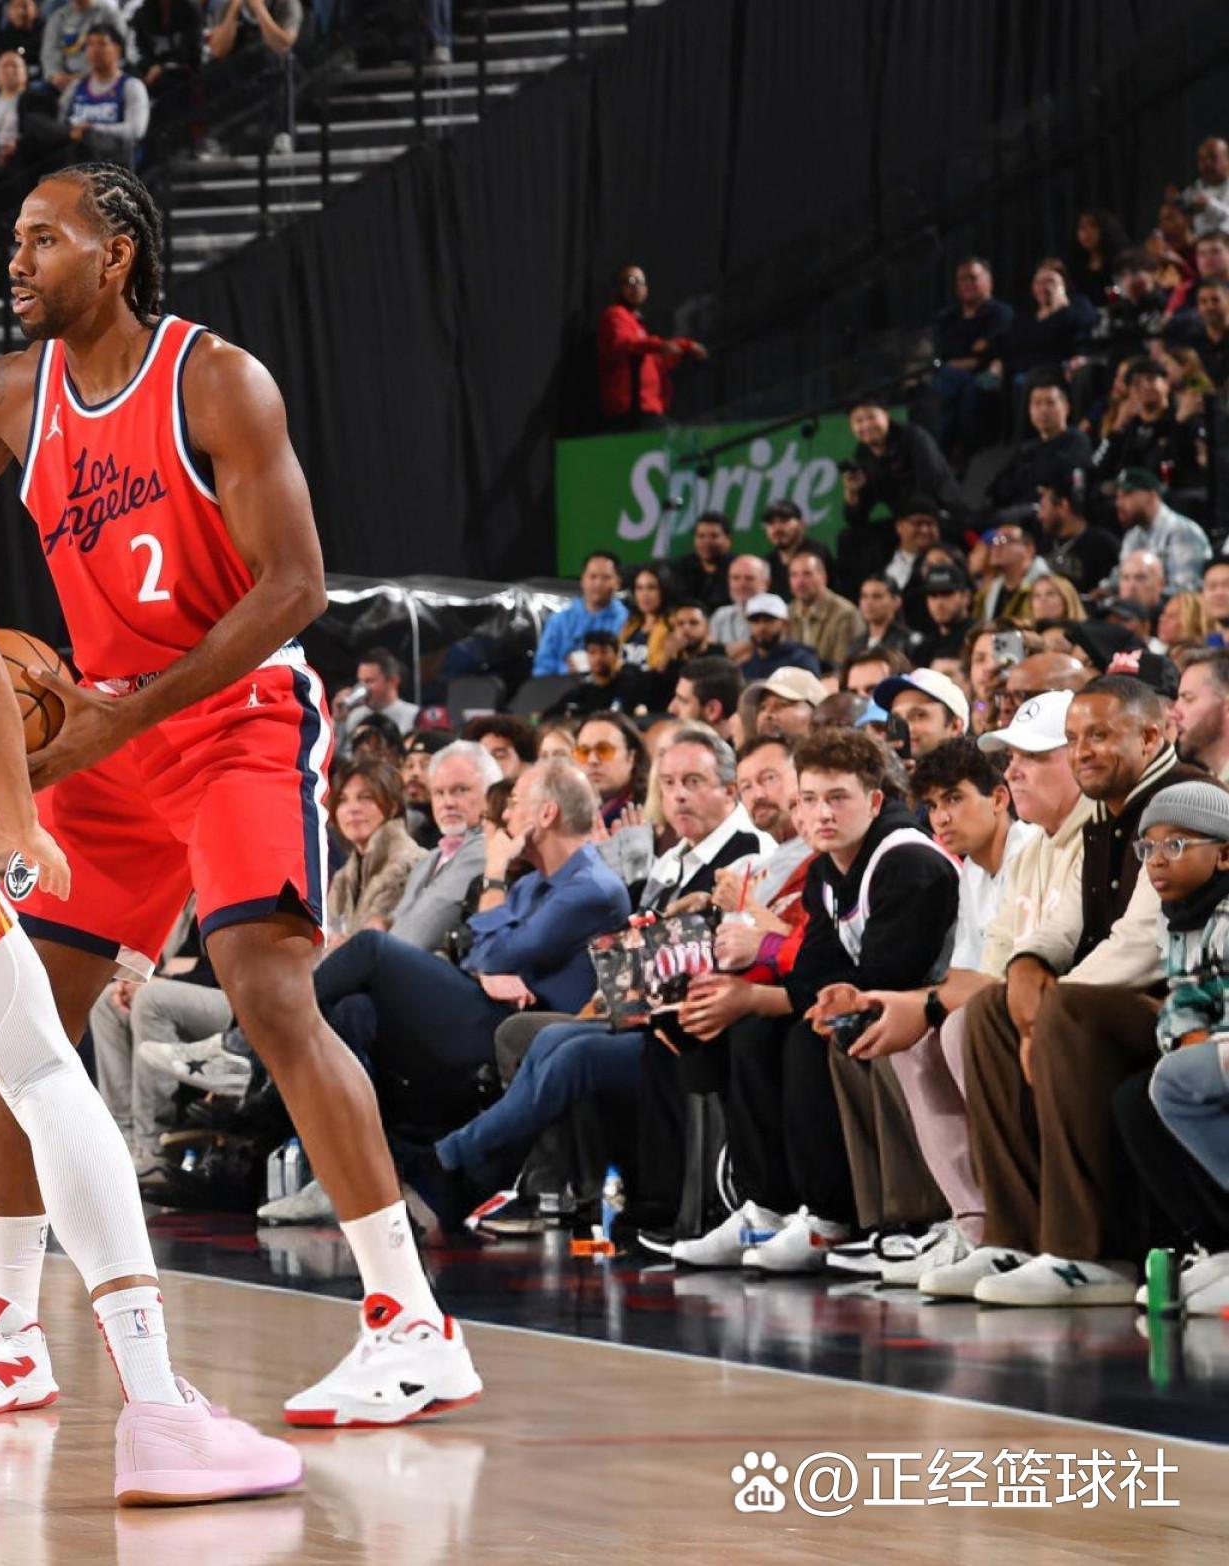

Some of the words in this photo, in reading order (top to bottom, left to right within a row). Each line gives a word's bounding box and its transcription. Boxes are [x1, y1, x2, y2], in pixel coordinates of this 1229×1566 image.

[67, 447, 120, 501] Los
[616, 436, 839, 559] Sprite
[130, 533, 171, 603] 2
